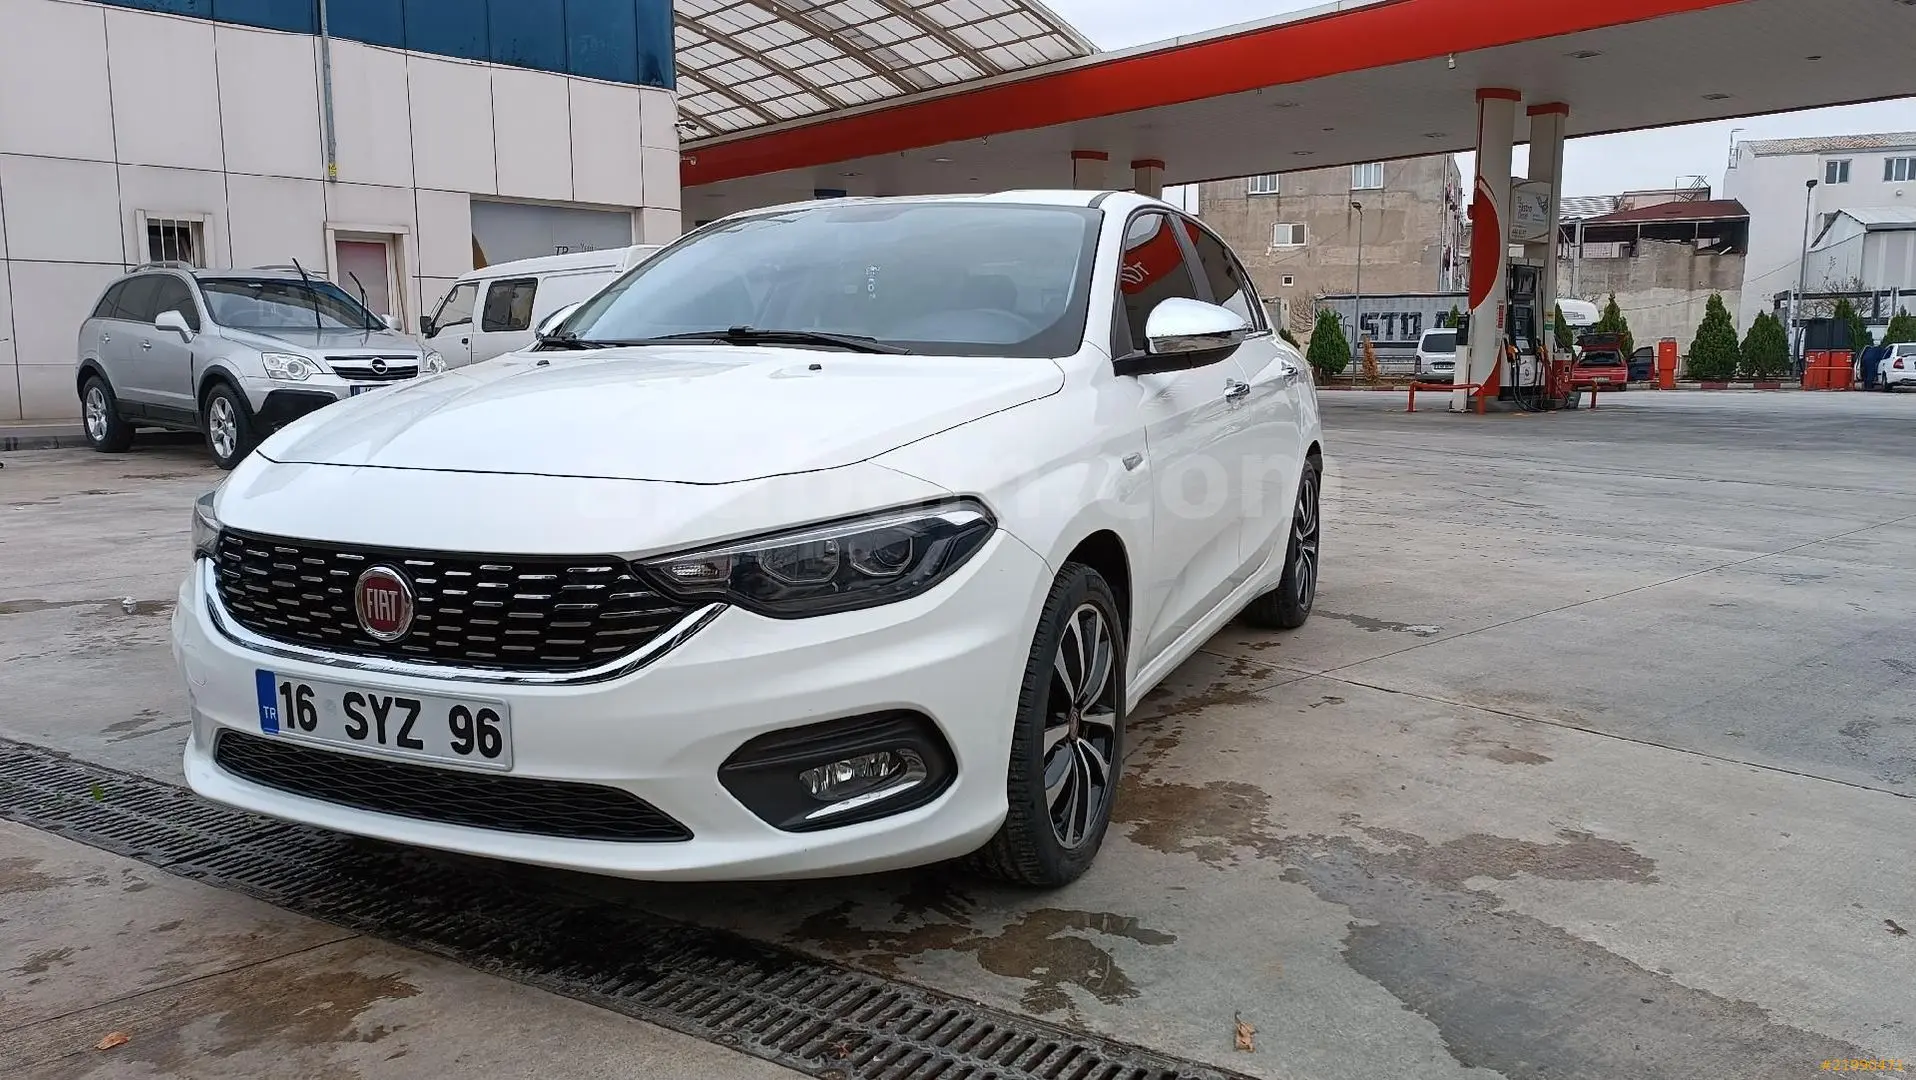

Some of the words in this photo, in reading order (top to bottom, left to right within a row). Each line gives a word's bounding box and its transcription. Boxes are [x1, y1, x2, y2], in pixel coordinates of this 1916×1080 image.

[366, 588, 398, 622] FIAT
[263, 705, 277, 721] TR
[280, 681, 318, 732] 16
[342, 691, 424, 750] SYZ
[448, 704, 502, 758] 96
